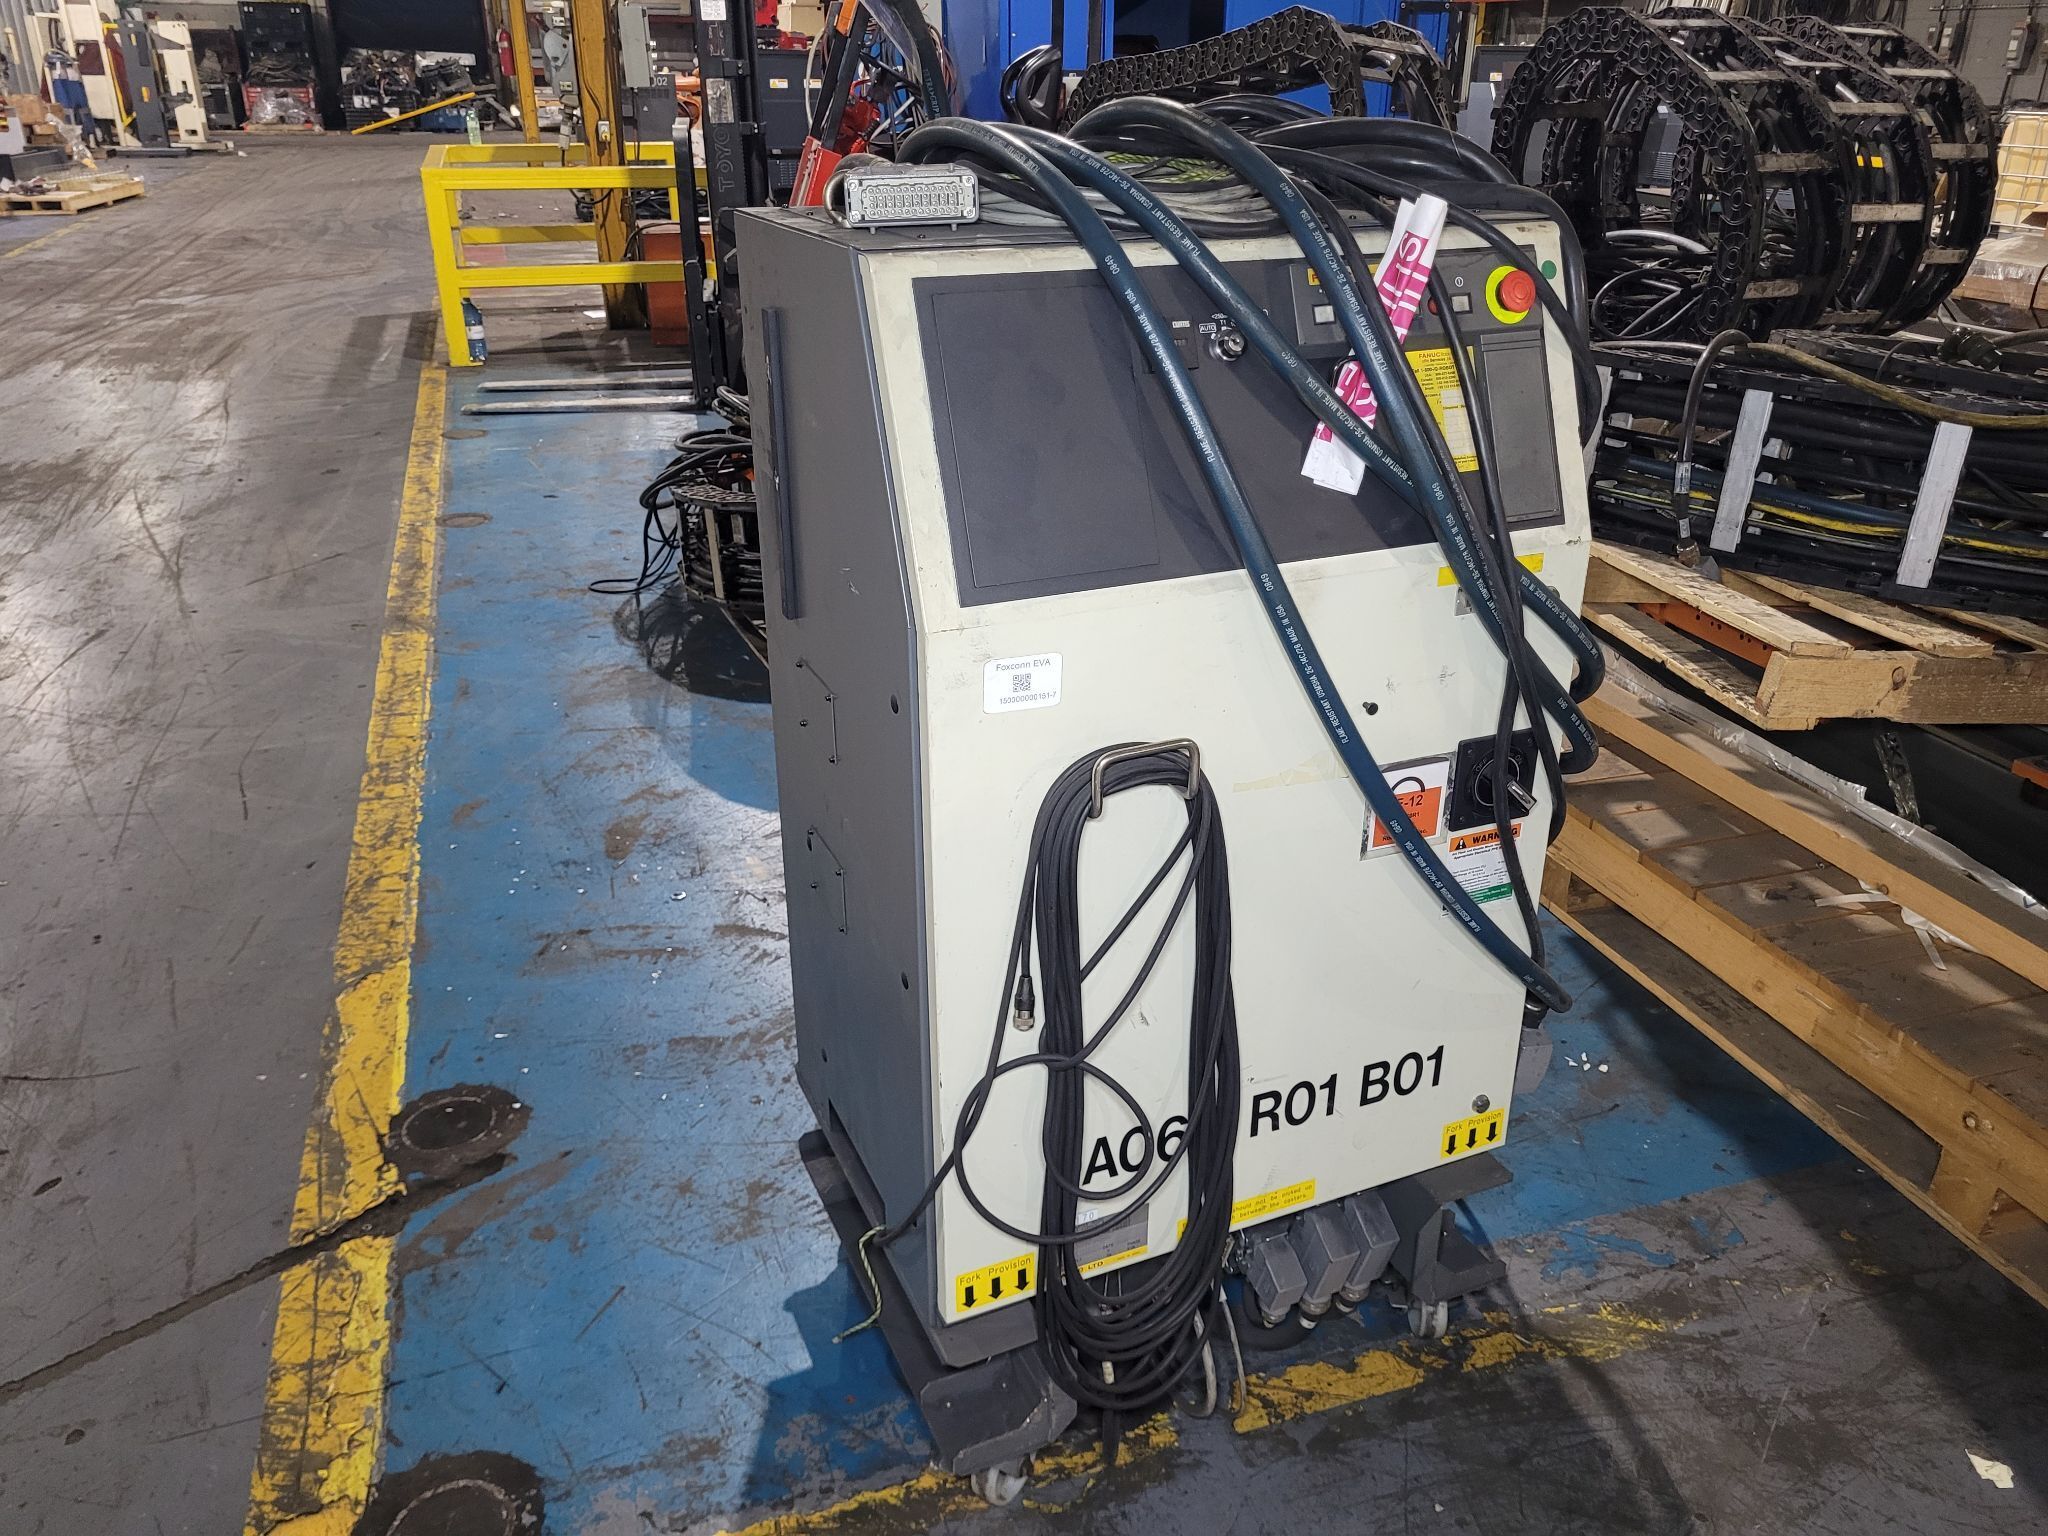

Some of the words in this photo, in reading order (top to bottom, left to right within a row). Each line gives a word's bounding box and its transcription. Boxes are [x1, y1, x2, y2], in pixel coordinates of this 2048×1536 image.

[712, 99, 734, 192] TOYO
[1067, 147, 1080, 156] USA
[1078, 153, 1086, 161] IN
[1084, 156, 1101, 170] MADE
[1128, 186, 1153, 209] USMSHA
[1278, 181, 1295, 198] 0849
[1151, 206, 1183, 238] RESISTANT
[1298, 207, 1311, 222] USA
[1307, 221, 1316, 229] IN
[1181, 235, 1200, 257] FLAME
[1311, 229, 1327, 248] MADE
[1103, 253, 1121, 274] 0849
[1123, 287, 1137, 303] USA
[1341, 283, 1361, 312] USMSHA
[1132, 303, 1142, 312] IN
[1137, 312, 1152, 332] MADE
[1355, 311, 1378, 348] RESISTANT
[1373, 348, 1388, 371] FLAME
[1418, 351, 1440, 359] FANUC
[1304, 375, 1318, 390] USA
[1315, 387, 1325, 398] IN
[1322, 394, 1338, 411] MADE
[1181, 400, 1205, 439] RESISTANT
[1199, 439, 1216, 462] FLAME
[1362, 434, 1384, 456] USMSHA
[1381, 454, 1409, 480] RESISTANT
[1429, 481, 1446, 501] 0849
[1444, 512, 1456, 526] USA
[1450, 525, 1459, 534] IN
[1453, 533, 1467, 550] MADE
[1258, 571, 1275, 592] 0849
[1518, 575, 1531, 586] USA
[1533, 587, 1548, 602] MADE
[1274, 603, 1287, 618] USA
[1281, 617, 1290, 626] IN
[1285, 625, 1299, 643] MADE
[996, 661, 1030, 672] Foxconn
[1033, 658, 1051, 667] EVA
[1308, 674, 1326, 698] USMSHA
[1320, 697, 1340, 727] RESISTANT
[1334, 725, 1349, 743] FLAME
[1472, 827, 1518, 844] WARNG
[1403, 839, 1415, 852] USA
[1414, 854, 1427, 868] MADE
[1451, 900, 1471, 922] RESISTANT
[1467, 918, 1481, 933] FLAME
[1250, 1073, 1338, 1137] R01
[1360, 1045, 1444, 1107] B01
[1446, 1124, 1462, 1133] Fork
[1468, 1112, 1502, 1127] Provision
[1082, 1115, 1188, 1186] A06
[959, 1272, 981, 1286] Fork
[988, 1257, 1031, 1276] Provision
[1088, 1261, 1104, 1270] LTD
